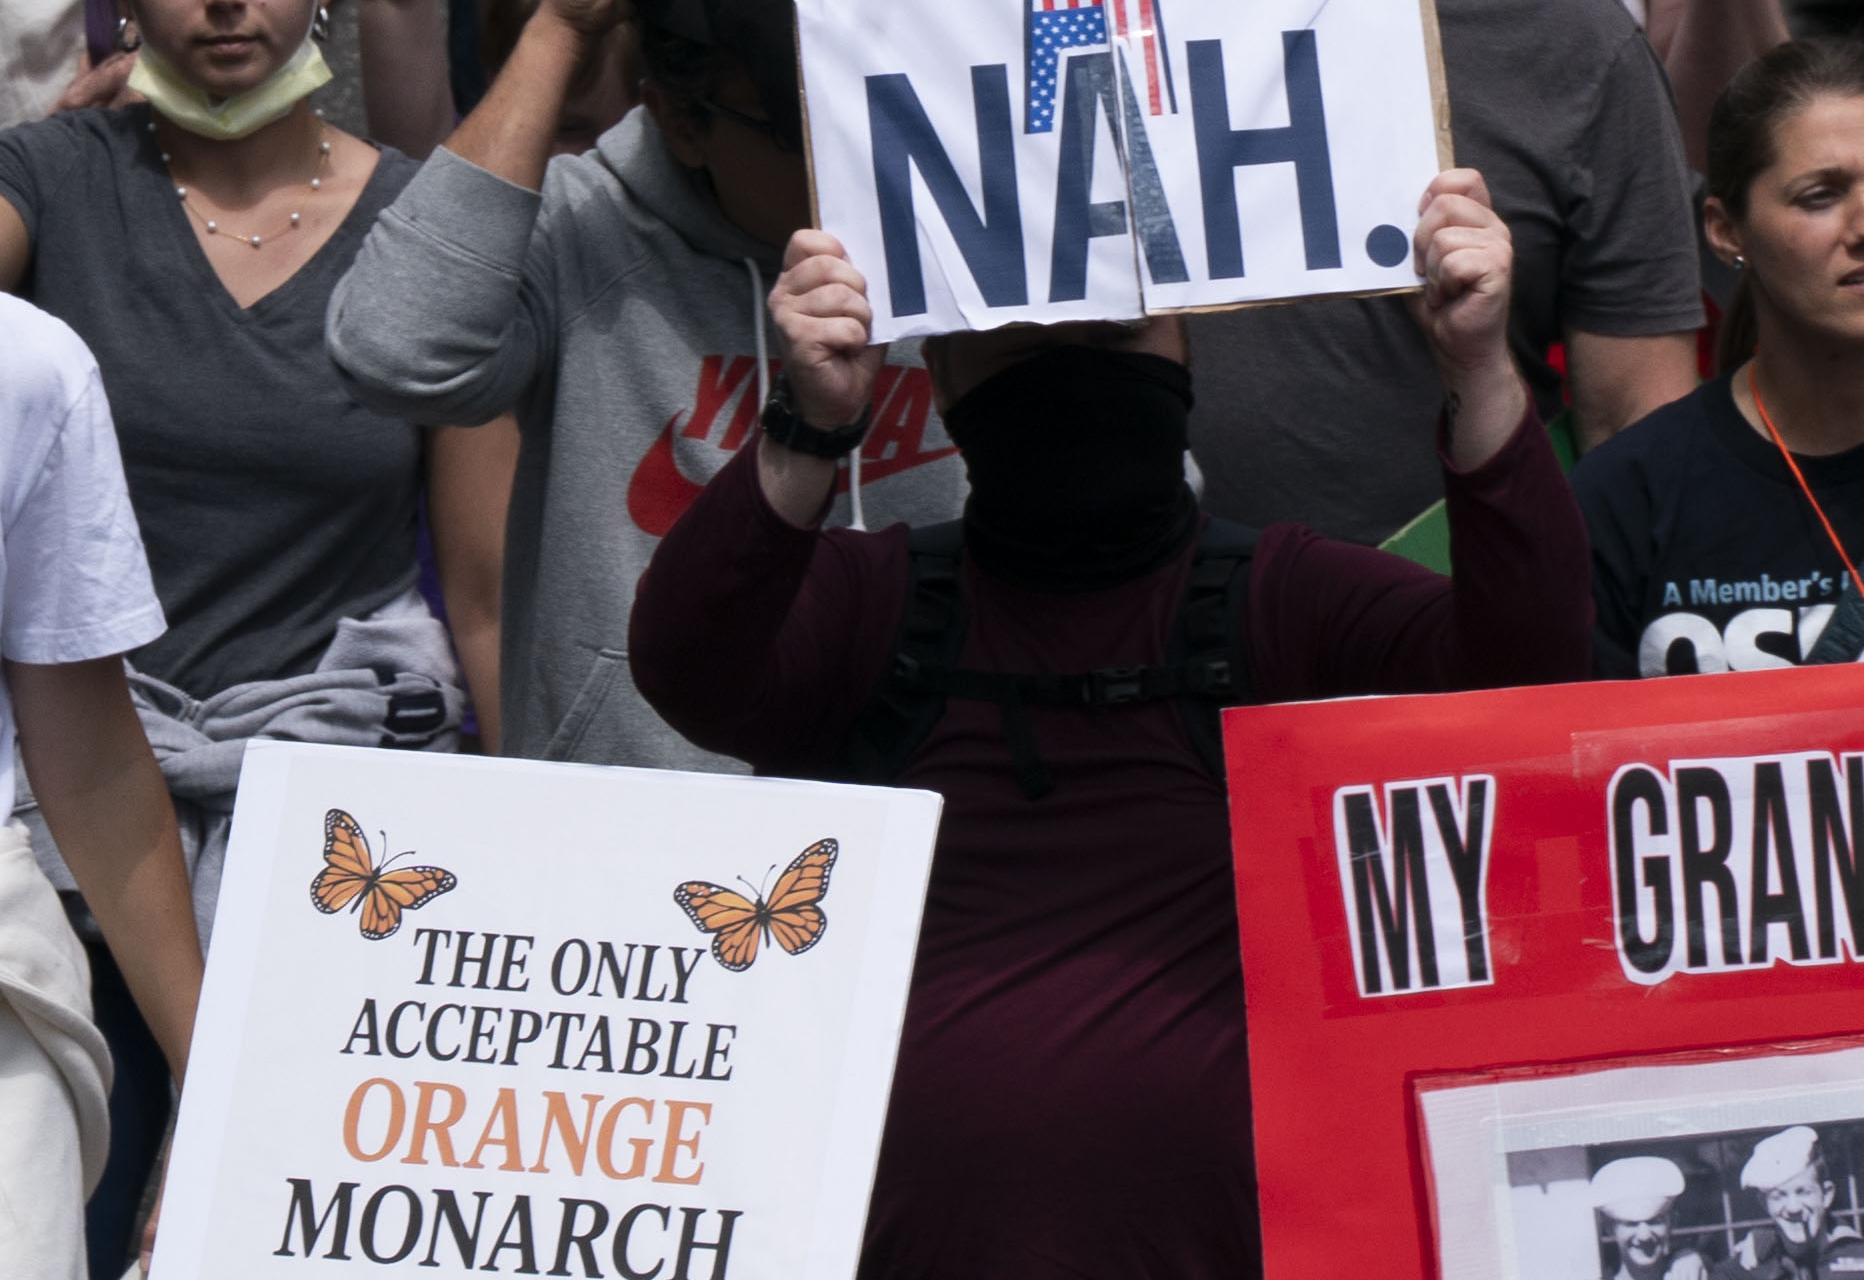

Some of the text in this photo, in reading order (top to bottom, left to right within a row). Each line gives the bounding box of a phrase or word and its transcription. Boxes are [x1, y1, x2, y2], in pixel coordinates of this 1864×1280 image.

[863, 28, 1410, 320] NAH.
[1662, 581, 1682, 607] A
[1689, 571, 1833, 605] Member's
[1341, 779, 1493, 991] MY
[414, 926, 708, 1005] THE ONLY
[341, 998, 738, 1082] ACCEPTABLE
[341, 1077, 714, 1187] ORANGE
